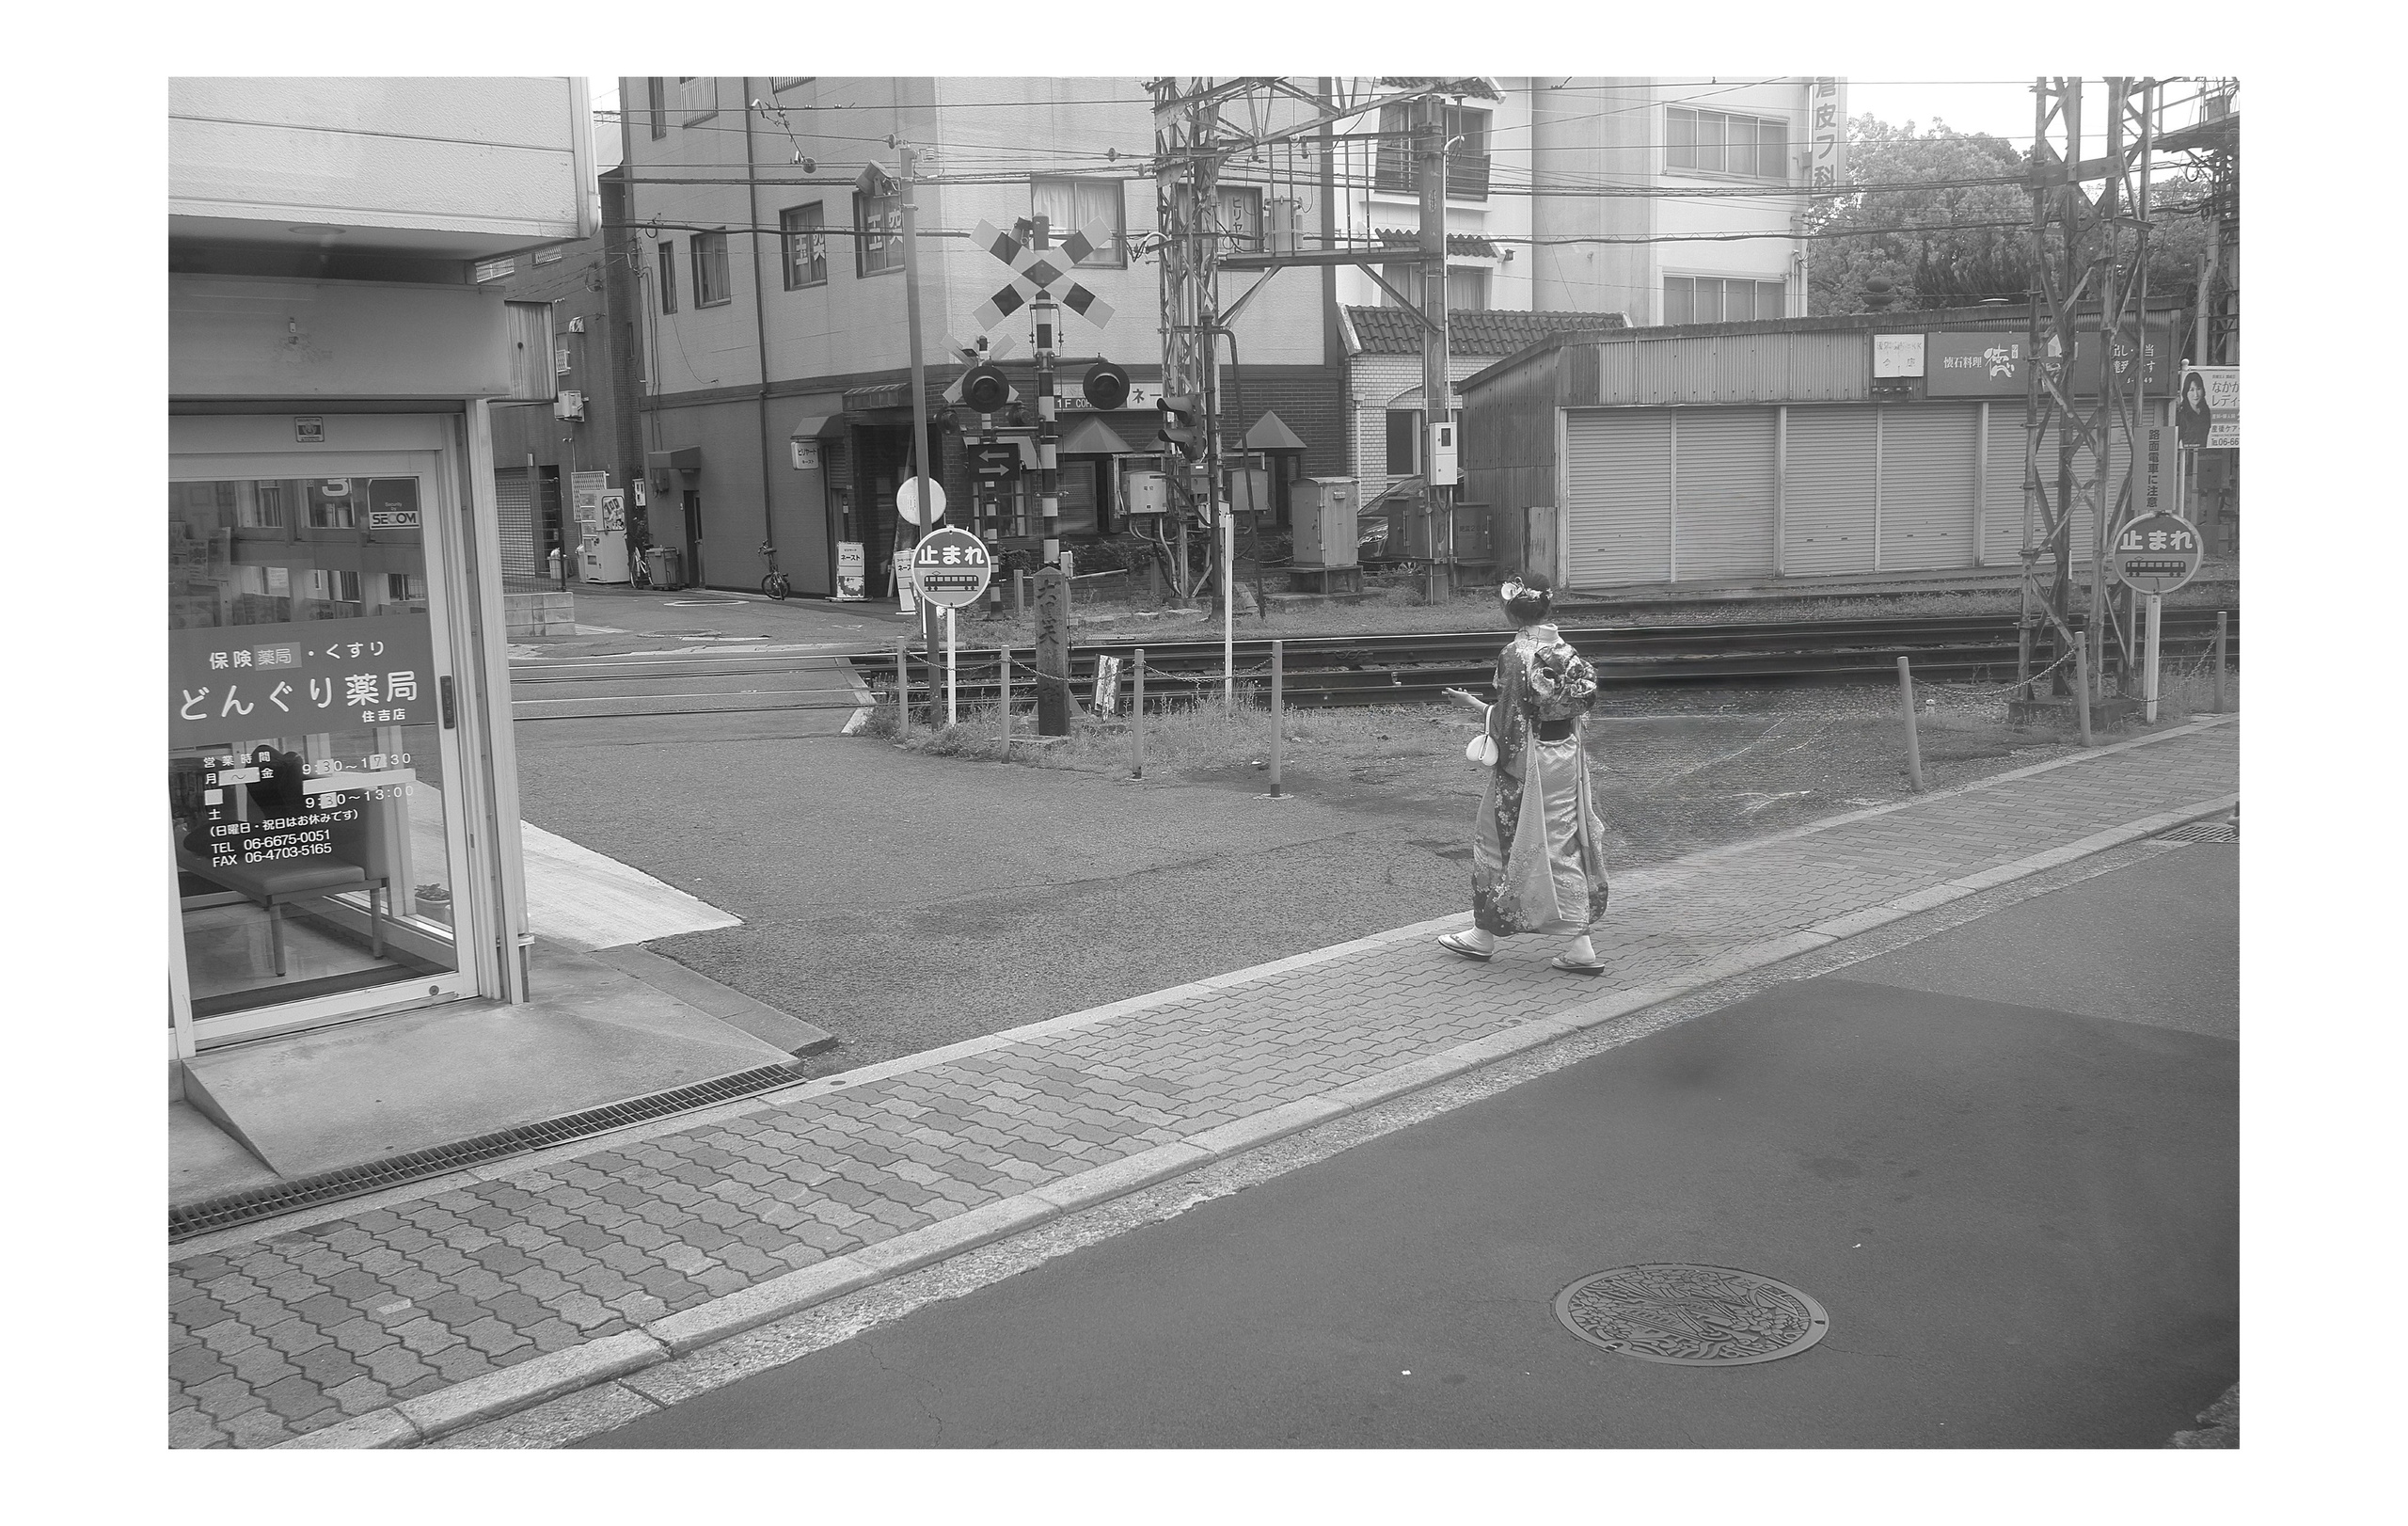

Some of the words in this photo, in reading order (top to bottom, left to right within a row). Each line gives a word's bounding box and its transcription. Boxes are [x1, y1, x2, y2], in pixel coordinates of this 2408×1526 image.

[1943, 357, 1982, 369] 懐石料理
[2146, 429, 2161, 508] 路面電車に注意
[372, 512, 417, 525] SECOM
[2119, 530, 2194, 551] 止まれ
[918, 545, 985, 565] 止まれ
[181, 670, 418, 721] どんぐり薬局
[361, 707, 405, 723] 住吉店
[203, 751, 271, 769] 営業時間
[208, 808, 222, 820] 土
[211, 841, 234, 853] TEL
[244, 829, 330, 850] 06-6675-0051
[213, 854, 237, 867] FAX
[245, 842, 332, 864] 06-4703-5165
